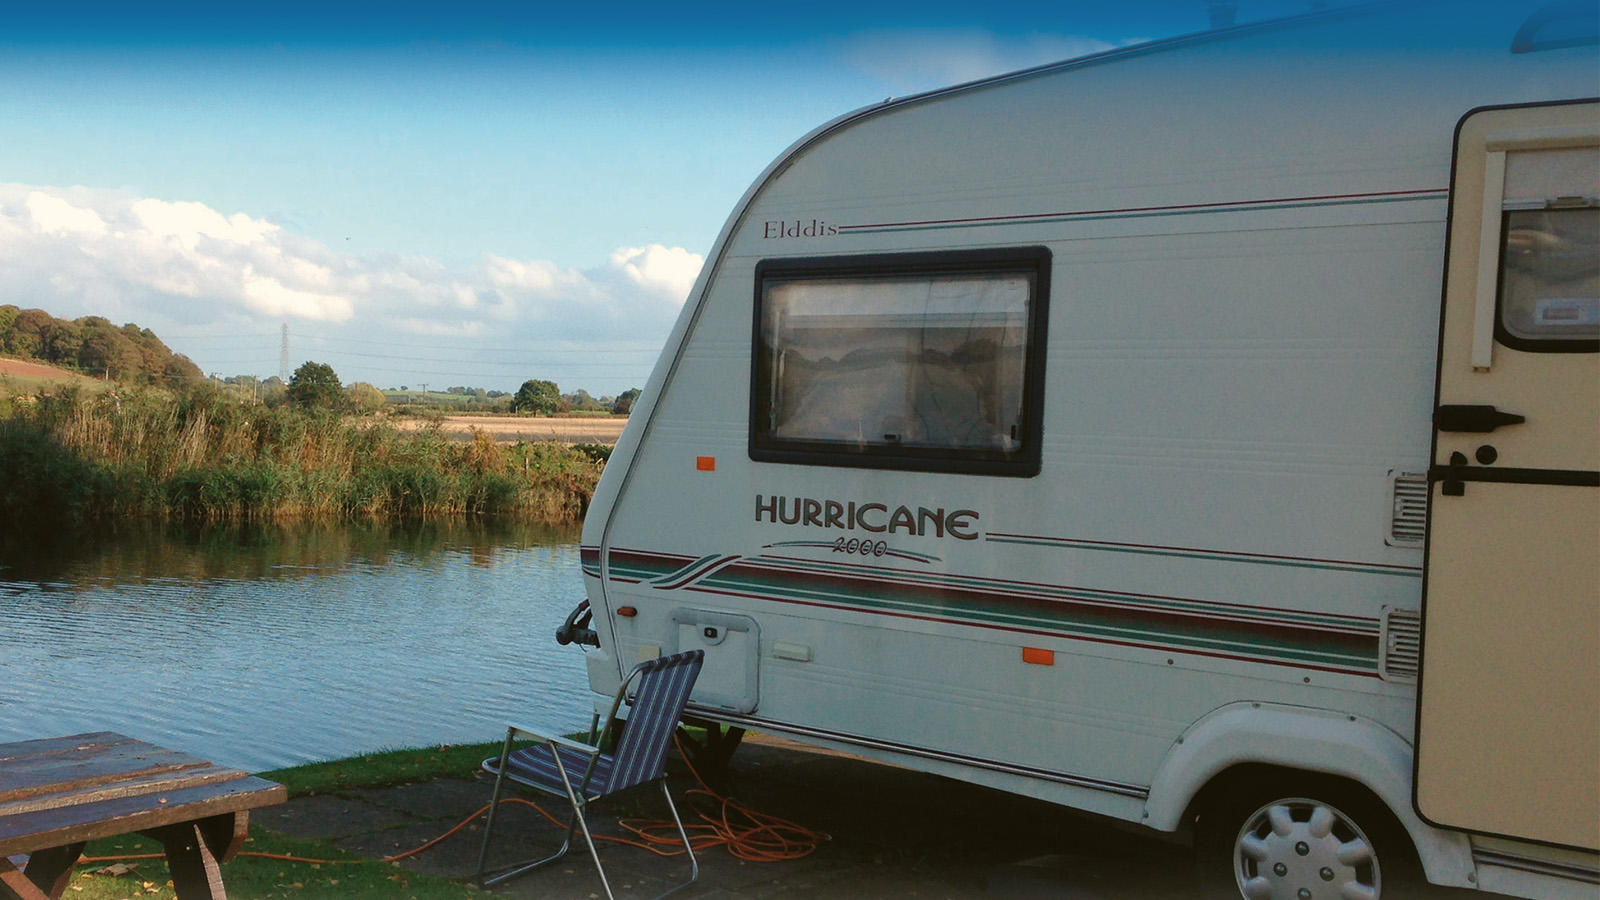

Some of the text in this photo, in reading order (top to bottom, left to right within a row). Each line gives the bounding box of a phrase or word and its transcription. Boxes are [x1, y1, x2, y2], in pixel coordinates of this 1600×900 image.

[763, 219, 838, 239] Elddis
[755, 494, 980, 541] HURRICANE
[832, 536, 888, 557] 2000
